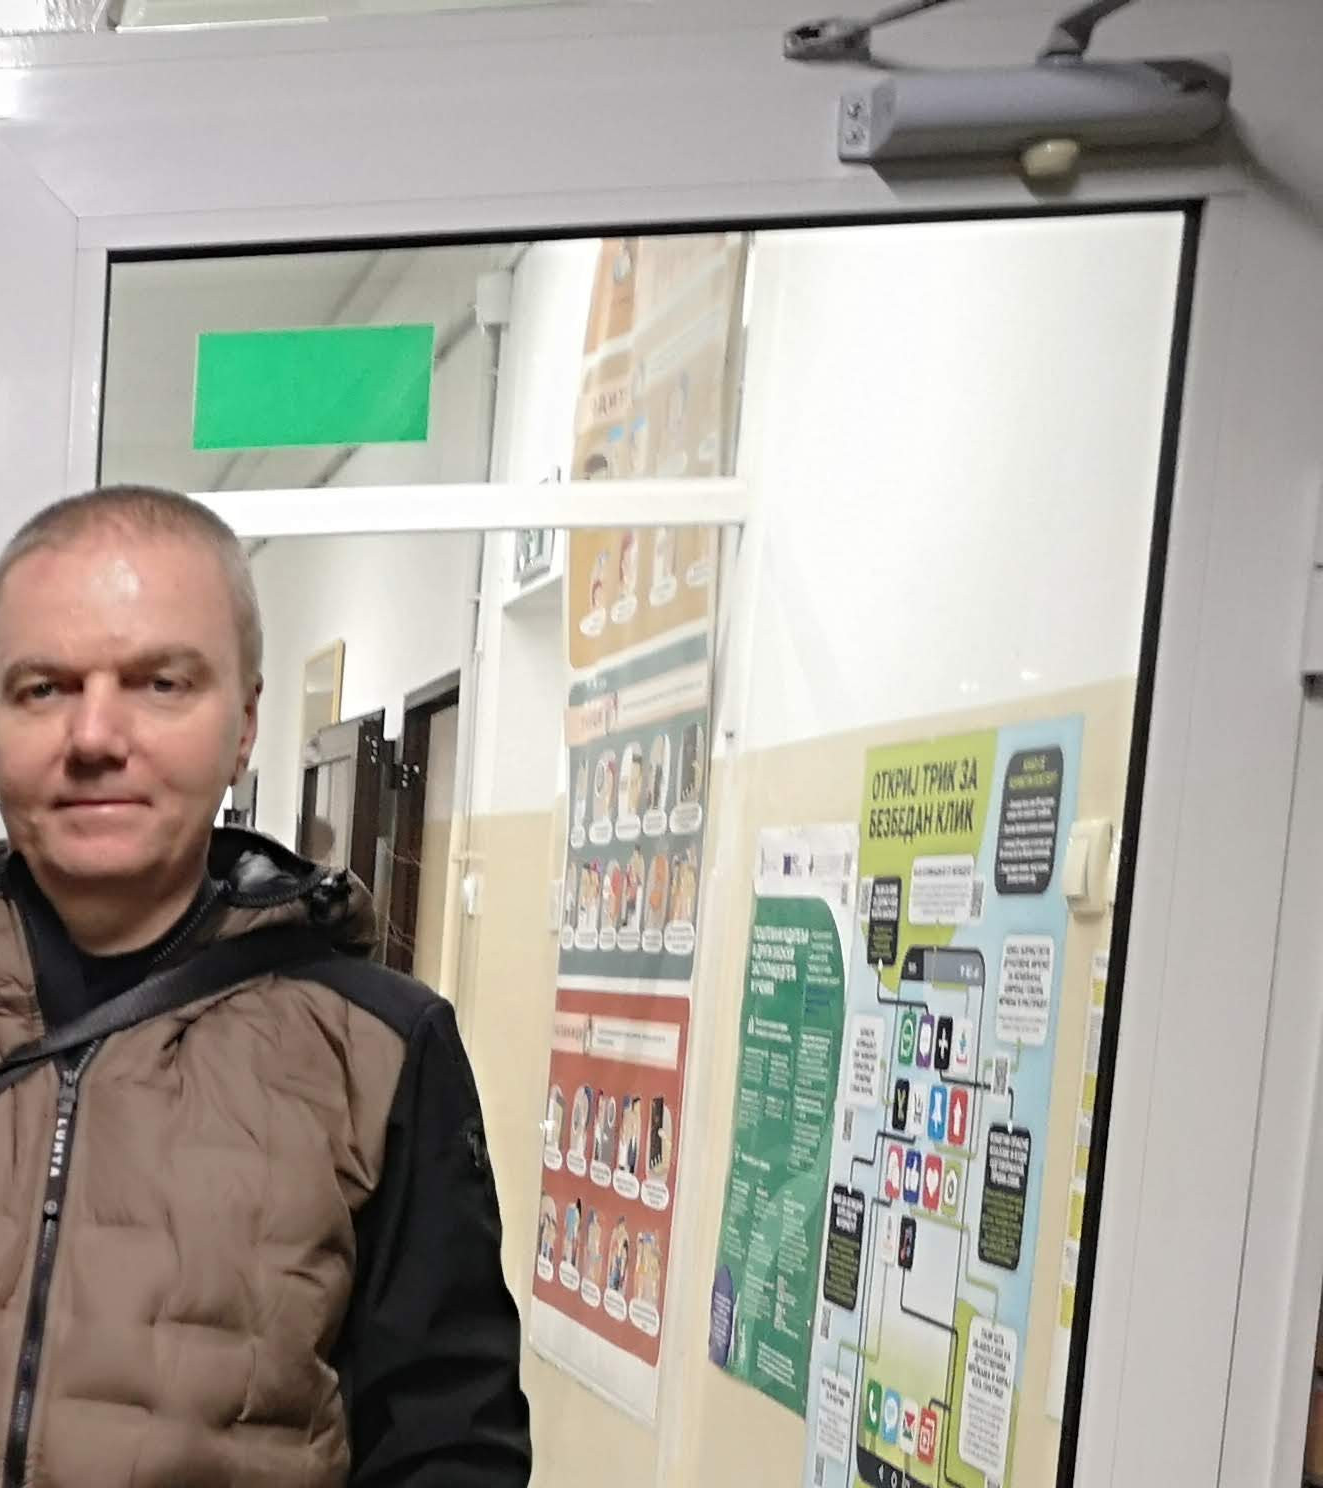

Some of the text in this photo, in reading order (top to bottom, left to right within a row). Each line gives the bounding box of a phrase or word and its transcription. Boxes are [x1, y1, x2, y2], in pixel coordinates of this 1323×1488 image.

[871, 764, 920, 801] ОТКРИЈ
[923, 759, 956, 796] ТРИК
[959, 755, 979, 792] ЗА
[868, 798, 975, 845] БЕЗБЕДАН КЛИК
